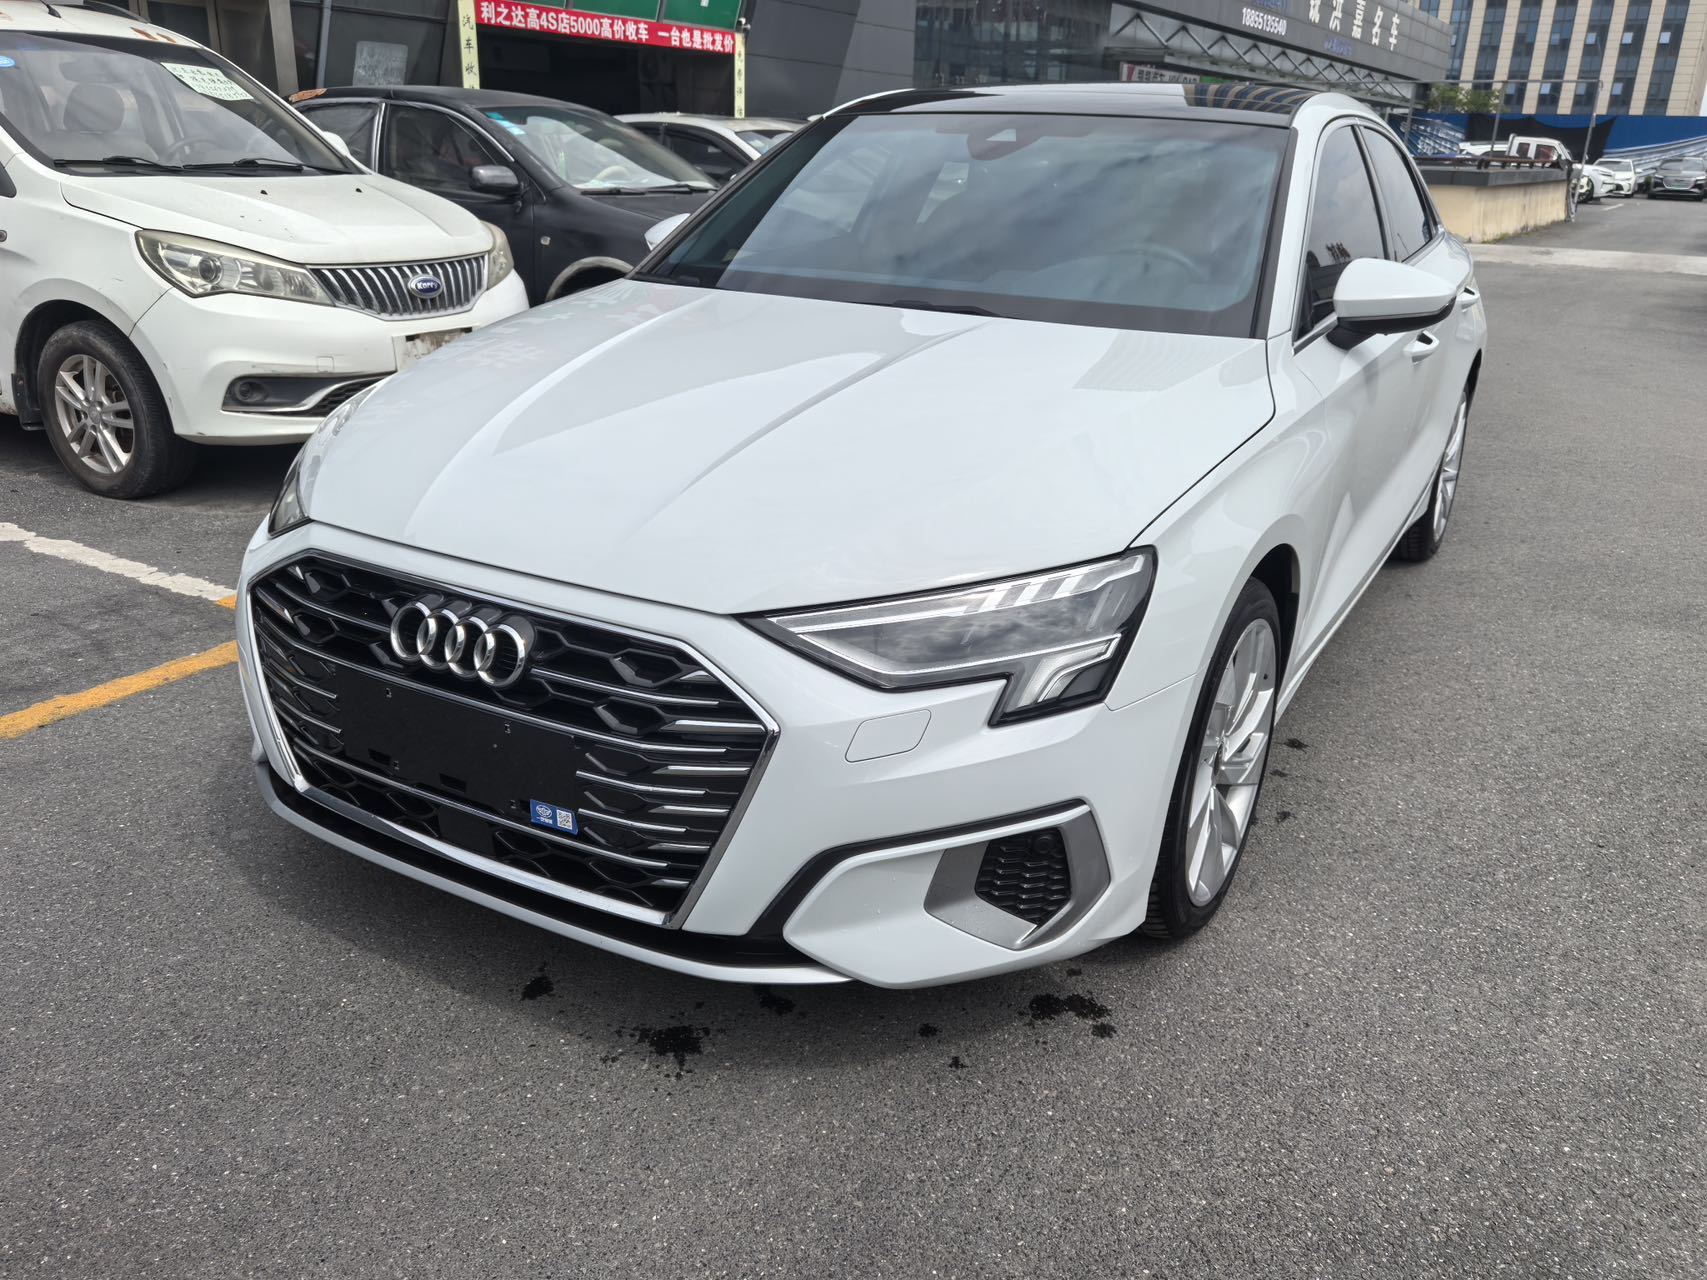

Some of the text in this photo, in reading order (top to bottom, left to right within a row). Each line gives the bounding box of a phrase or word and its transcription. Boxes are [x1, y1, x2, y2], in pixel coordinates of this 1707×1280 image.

[480, 1, 734, 53] 利之达高4S店5000高价收车 一台也是批发价
